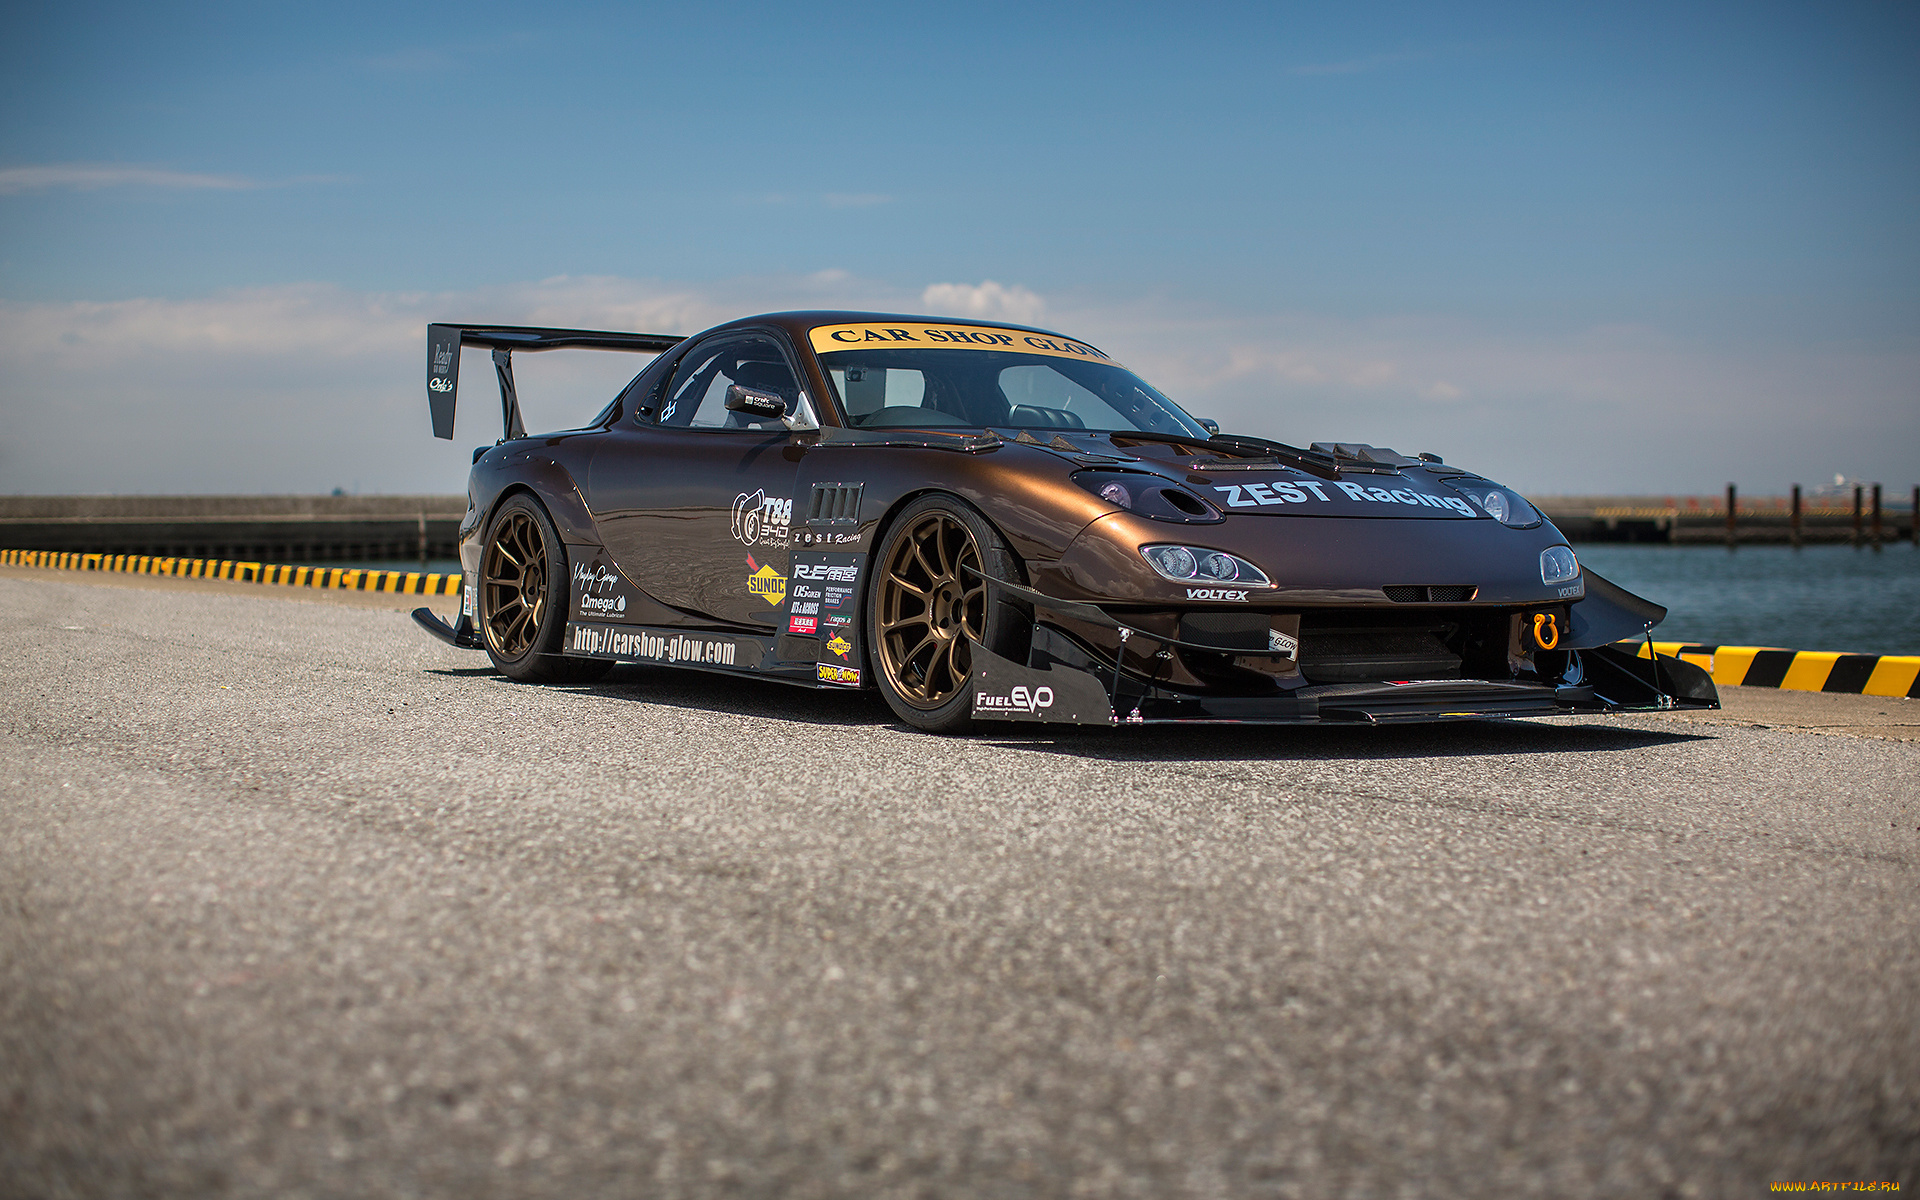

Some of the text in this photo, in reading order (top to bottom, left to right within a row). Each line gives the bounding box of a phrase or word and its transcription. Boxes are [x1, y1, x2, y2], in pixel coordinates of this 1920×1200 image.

[830, 328, 921, 343] CAR
[923, 329, 1014, 347] SHOP
[1213, 480, 1478, 518] ZEST Racing
[763, 497, 793, 526] T88
[794, 533, 862, 545] zest Racing
[1186, 588, 1250, 601] VOLTEX
[1558, 586, 1581, 597] VOLTEX
[573, 626, 737, 665] http://carshop-glow.com
[1273, 636, 1298, 651] GLOW
[818, 665, 858, 682] SUPER NOW
[1010, 686, 1054, 713] EVO
